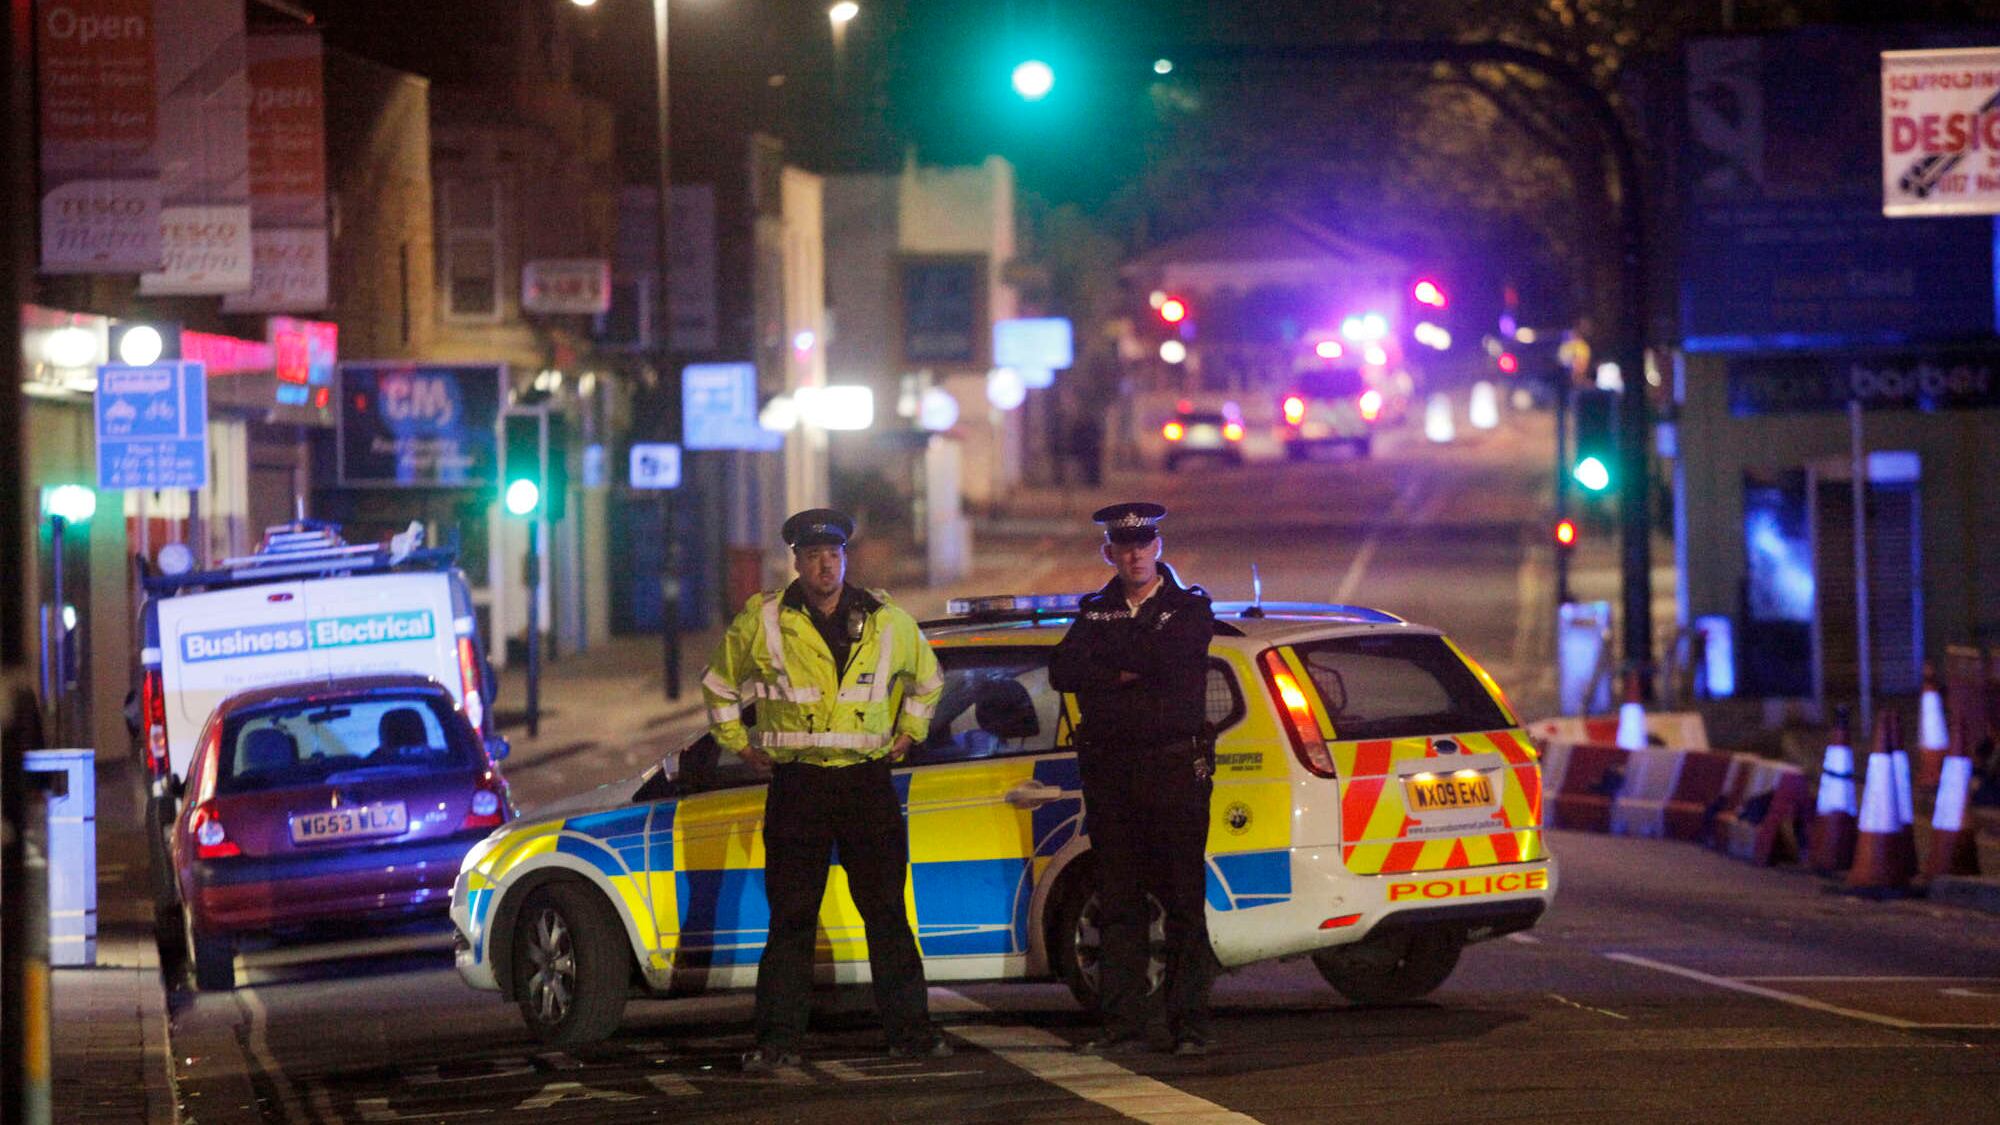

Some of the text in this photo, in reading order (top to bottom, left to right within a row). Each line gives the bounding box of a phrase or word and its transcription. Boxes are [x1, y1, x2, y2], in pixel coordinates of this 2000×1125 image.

[48, 7, 144, 45] Open
[256, 87, 314, 113] pen
[62, 198, 146, 216] TESCO
[186, 614, 430, 660] Business Electrical
[1416, 780, 1491, 806] WX09 EKU
[301, 808, 395, 836] WG53 WLX
[1390, 872, 1546, 901] POLICE
